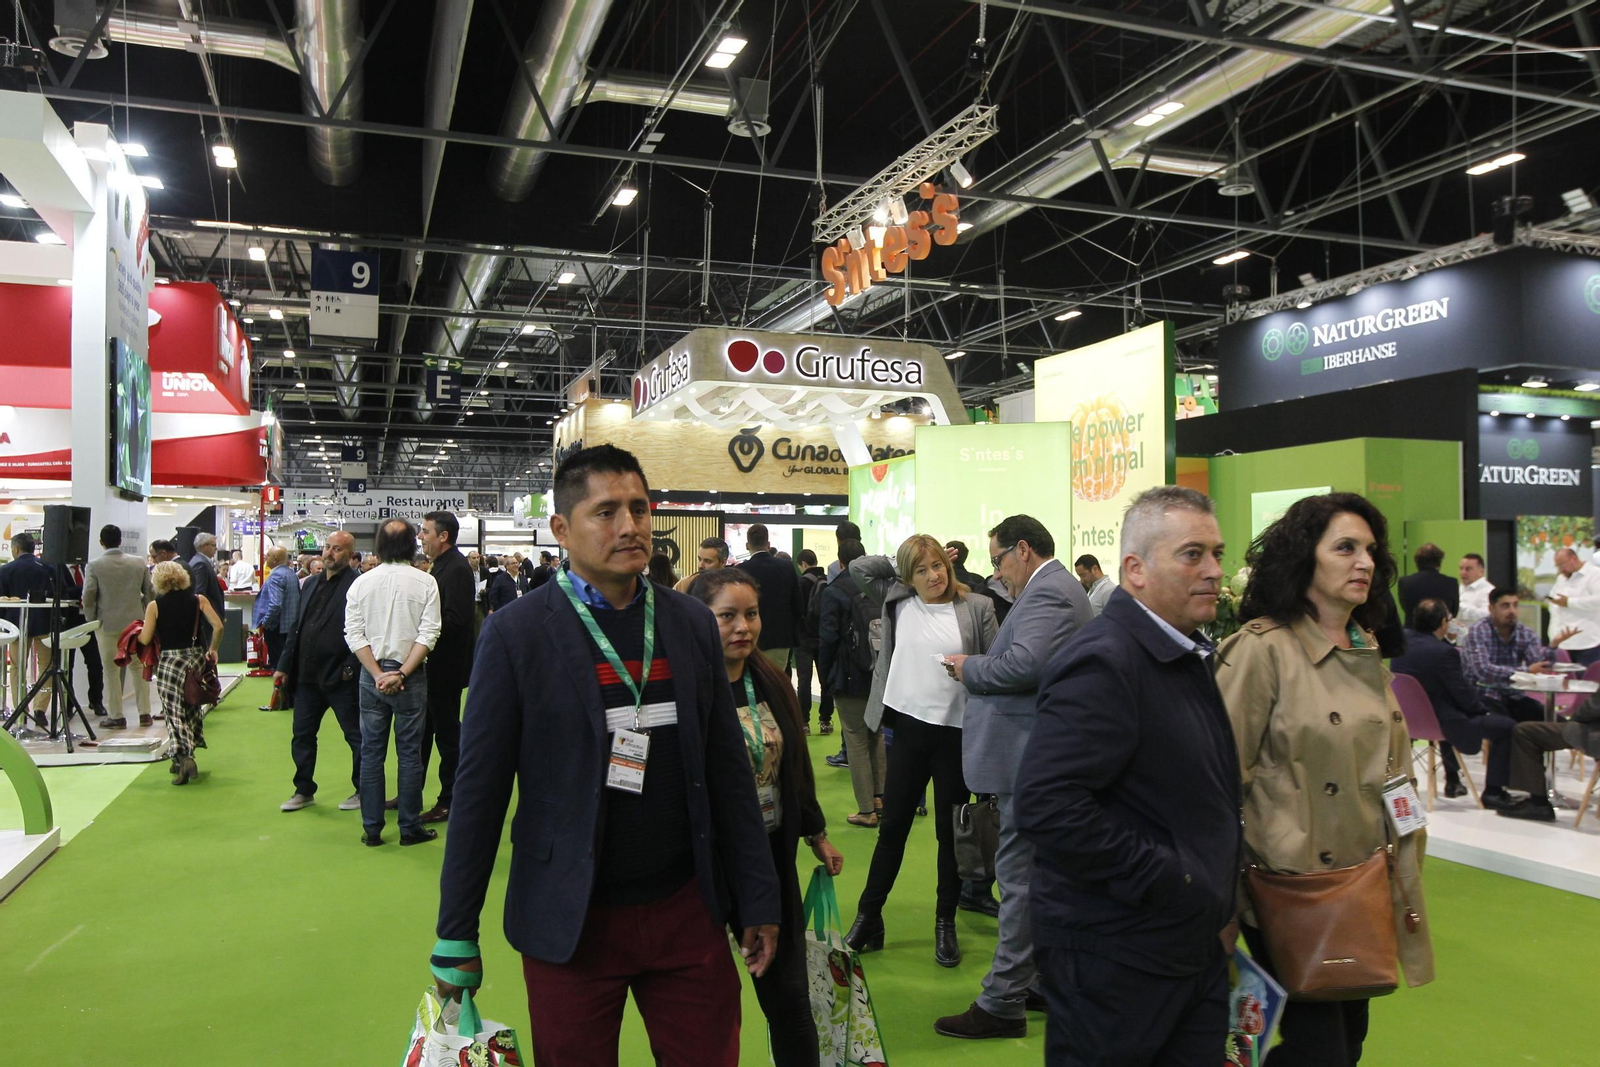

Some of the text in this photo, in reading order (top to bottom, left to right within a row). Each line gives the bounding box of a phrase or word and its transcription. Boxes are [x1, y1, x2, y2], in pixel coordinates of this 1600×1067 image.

[352, 261, 371, 288] 9
[795, 346, 922, 385] Grufesa
[1323, 342, 1397, 370] IBERHANSE
[162, 377, 216, 392] UNION
[436, 375, 451, 399] E
[650, 351, 690, 401] Grufesa
[1088, 412, 1144, 442] power
[356, 449, 364, 460] 9
[804, 467, 841, 475] GLOBAL
[1478, 463, 1580, 486] ATURGREEN
[358, 483, 364, 491] 9
[386, 495, 465, 508] Restaurante
